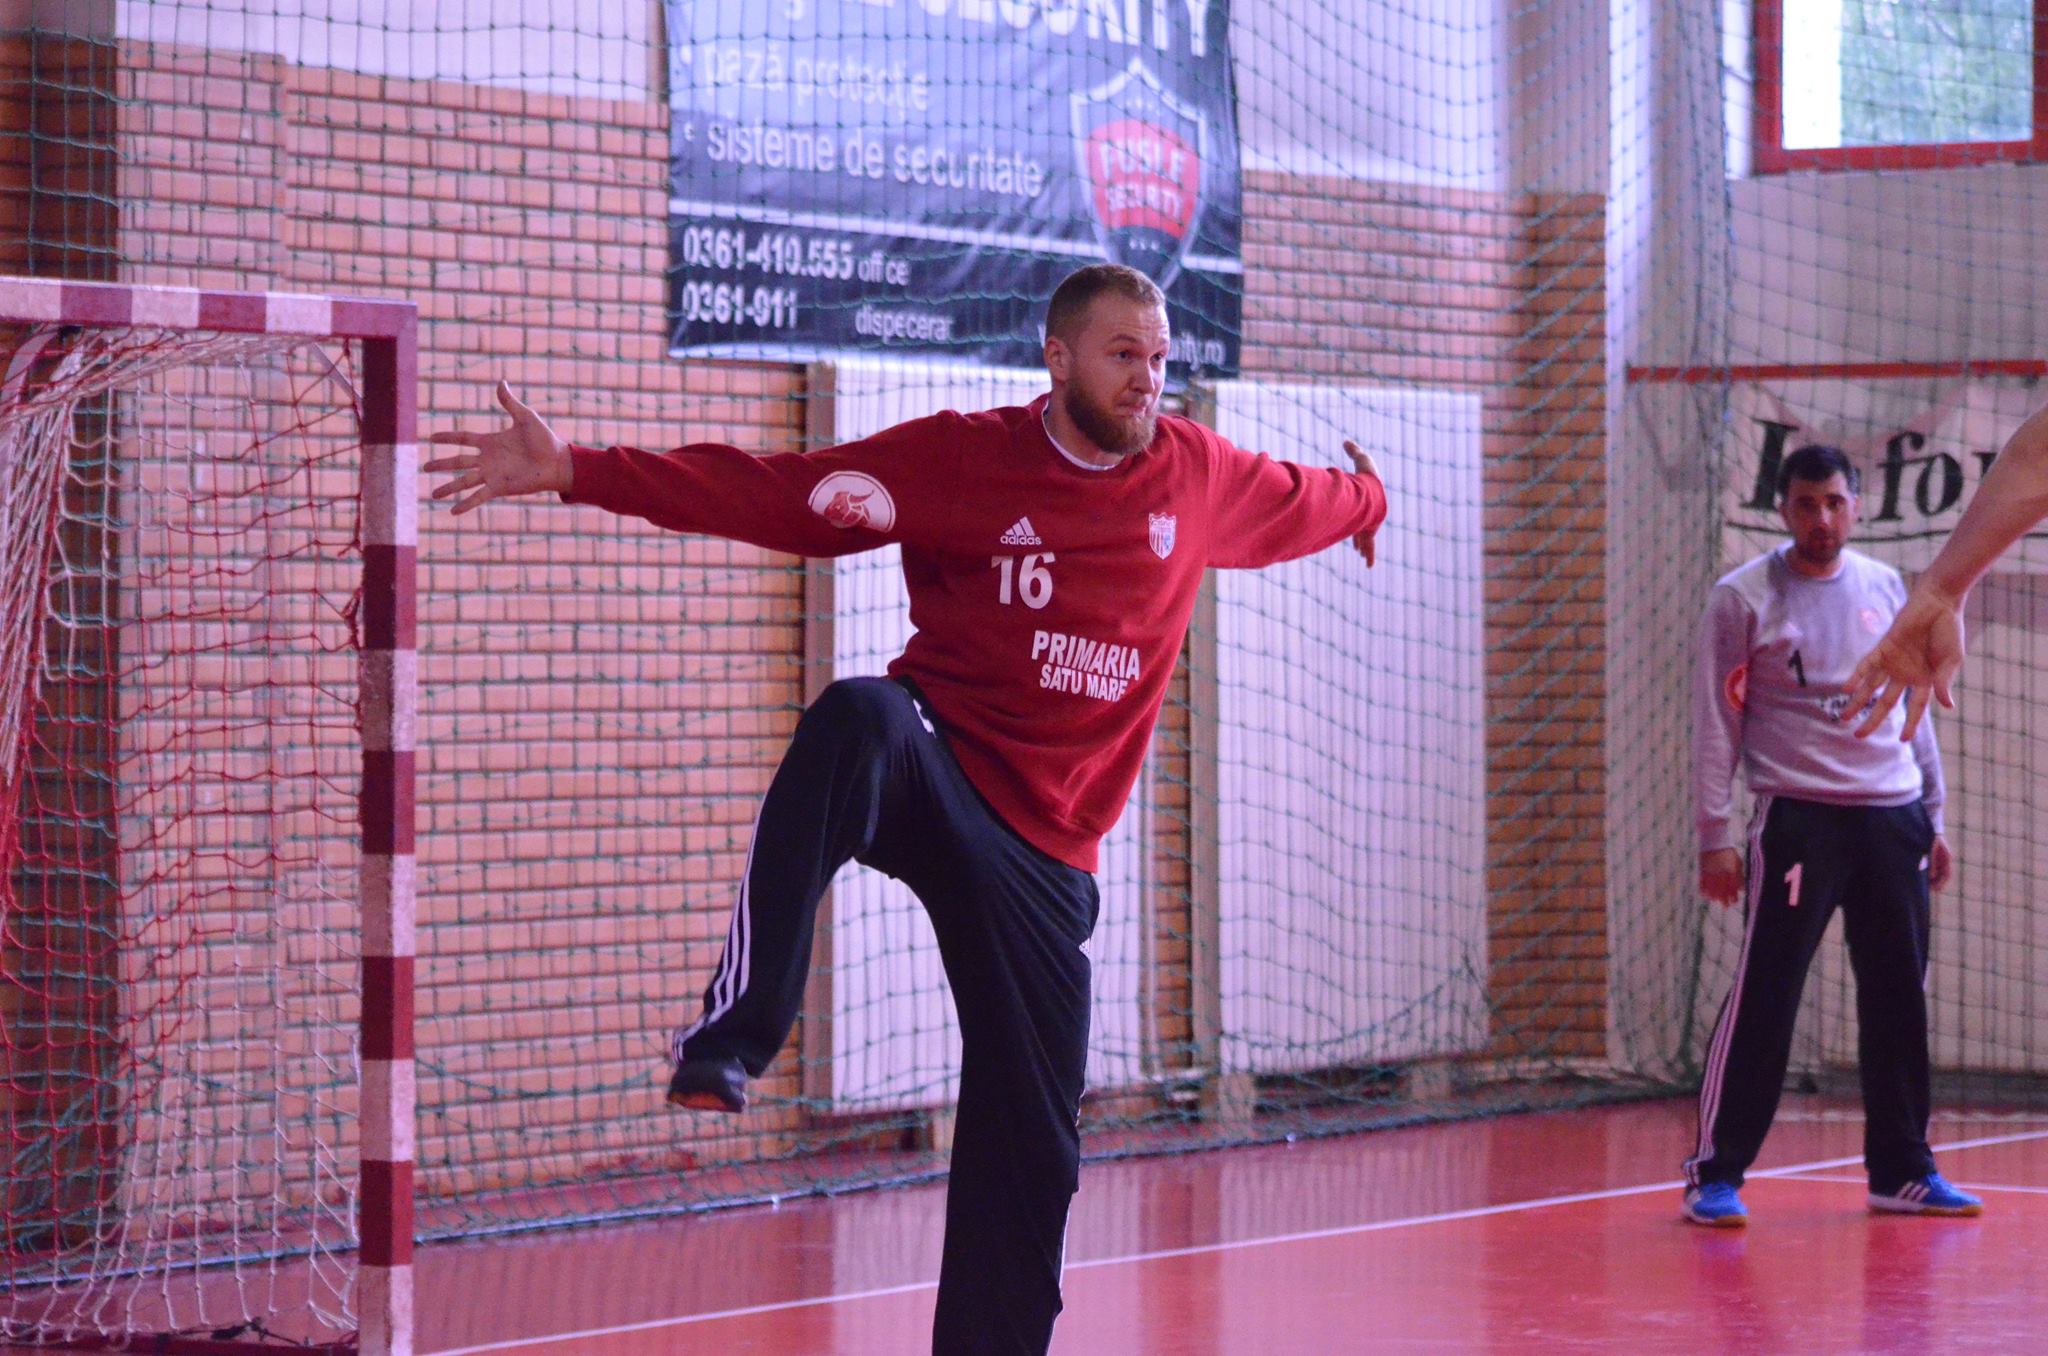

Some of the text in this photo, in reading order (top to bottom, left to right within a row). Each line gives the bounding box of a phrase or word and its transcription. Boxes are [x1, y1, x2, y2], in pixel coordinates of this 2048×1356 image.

[706, 117, 1043, 199] sisteme de securitate
[682, 225, 911, 286] 0361-410.555 offce
[681, 280, 798, 330] 0361-911
[1000, 535, 1042, 546] adidas
[991, 551, 1056, 610] 16
[1031, 629, 1140, 681] PRIMARIA
[1039, 663, 1083, 695] SATU
[1787, 649, 1807, 688] 1
[1784, 862, 1803, 907] 1
